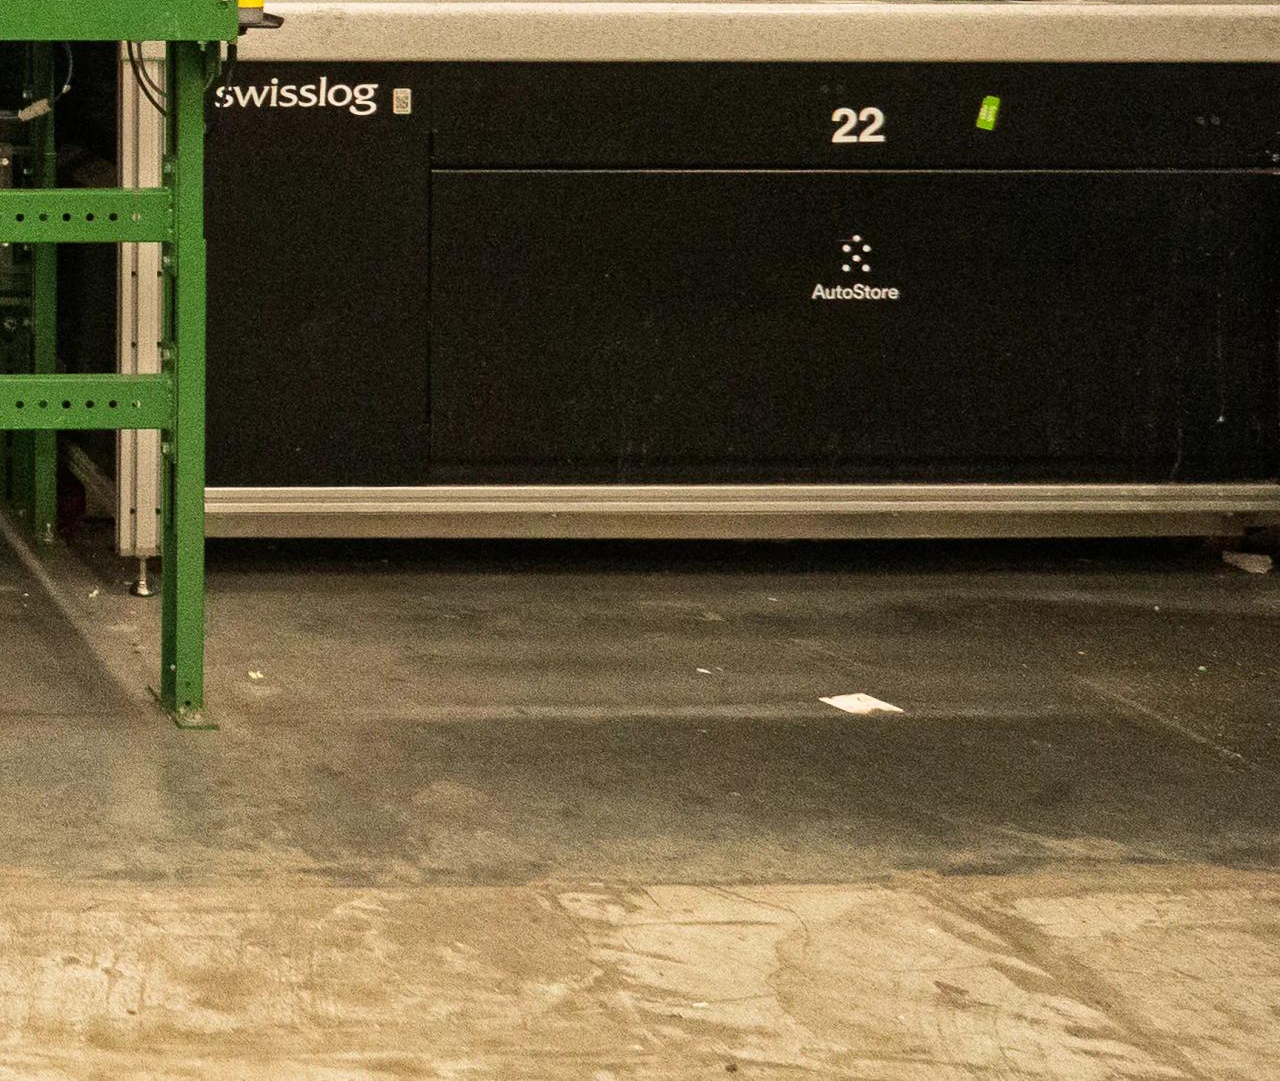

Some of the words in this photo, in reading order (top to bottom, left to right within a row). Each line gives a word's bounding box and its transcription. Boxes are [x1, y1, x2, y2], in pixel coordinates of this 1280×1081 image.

[215, 76, 379, 116] swisslog
[831, 106, 886, 143] 22
[811, 283, 900, 300] AutoStore
